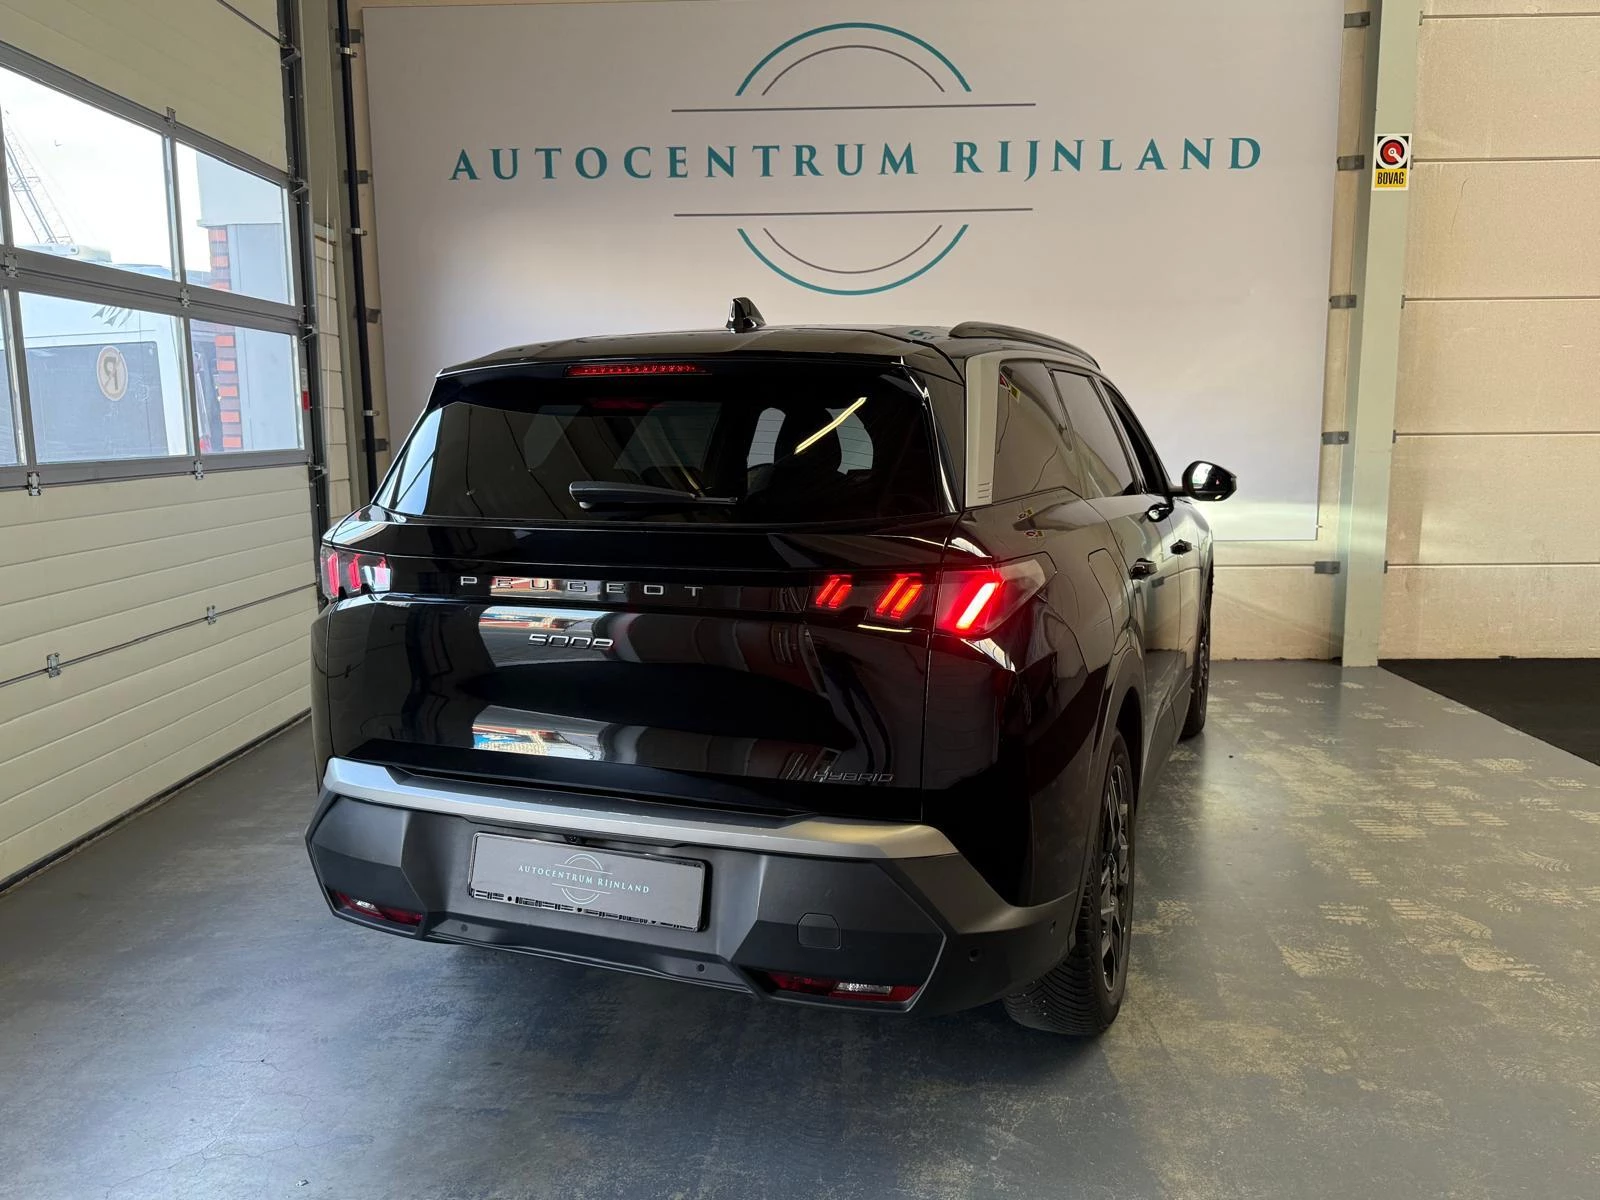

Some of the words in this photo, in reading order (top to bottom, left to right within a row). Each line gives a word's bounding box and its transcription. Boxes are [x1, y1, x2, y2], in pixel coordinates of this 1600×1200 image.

[450, 143, 918, 181] AUTOCENTRUM
[953, 137, 1262, 182] RIJNLAND
[1377, 171, 1405, 185] BOVAG
[460, 575, 704, 597] PEUGEOT
[527, 633, 614, 650] 5008
[812, 771, 894, 783] HYBRID
[518, 864, 593, 885] AUTOCENTRUM
[597, 877, 650, 894] RIJNLAND
